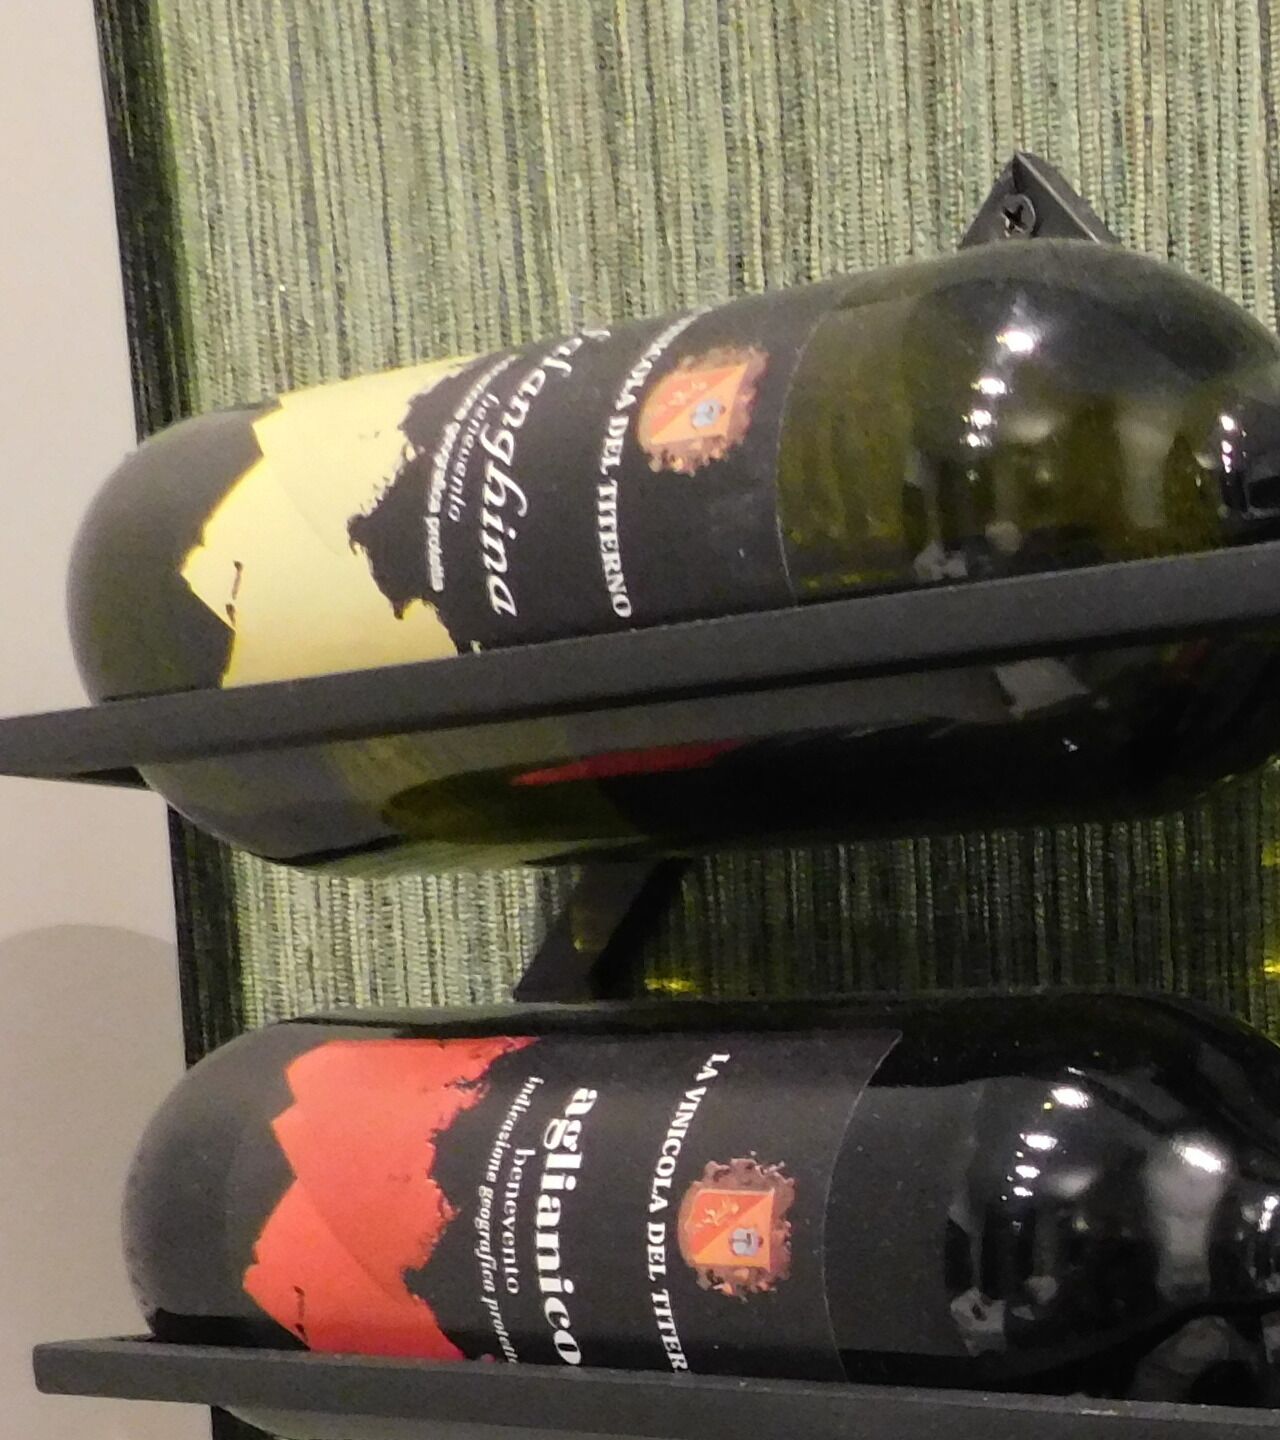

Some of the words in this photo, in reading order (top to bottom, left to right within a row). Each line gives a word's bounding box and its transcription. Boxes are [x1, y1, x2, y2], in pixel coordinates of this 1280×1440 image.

[600, 415, 629, 476] DEL
[597, 479, 632, 618] TITERNO
[695, 1053, 731, 1082] LA
[486, 1075, 545, 1183] indicazione
[648, 1086, 708, 1214] VINICOLA
[473, 1185, 496, 1293] geografica
[501, 1148, 536, 1295] benevento
[536, 1088, 598, 1365] aglianico
[646, 1222, 668, 1282] DEL
